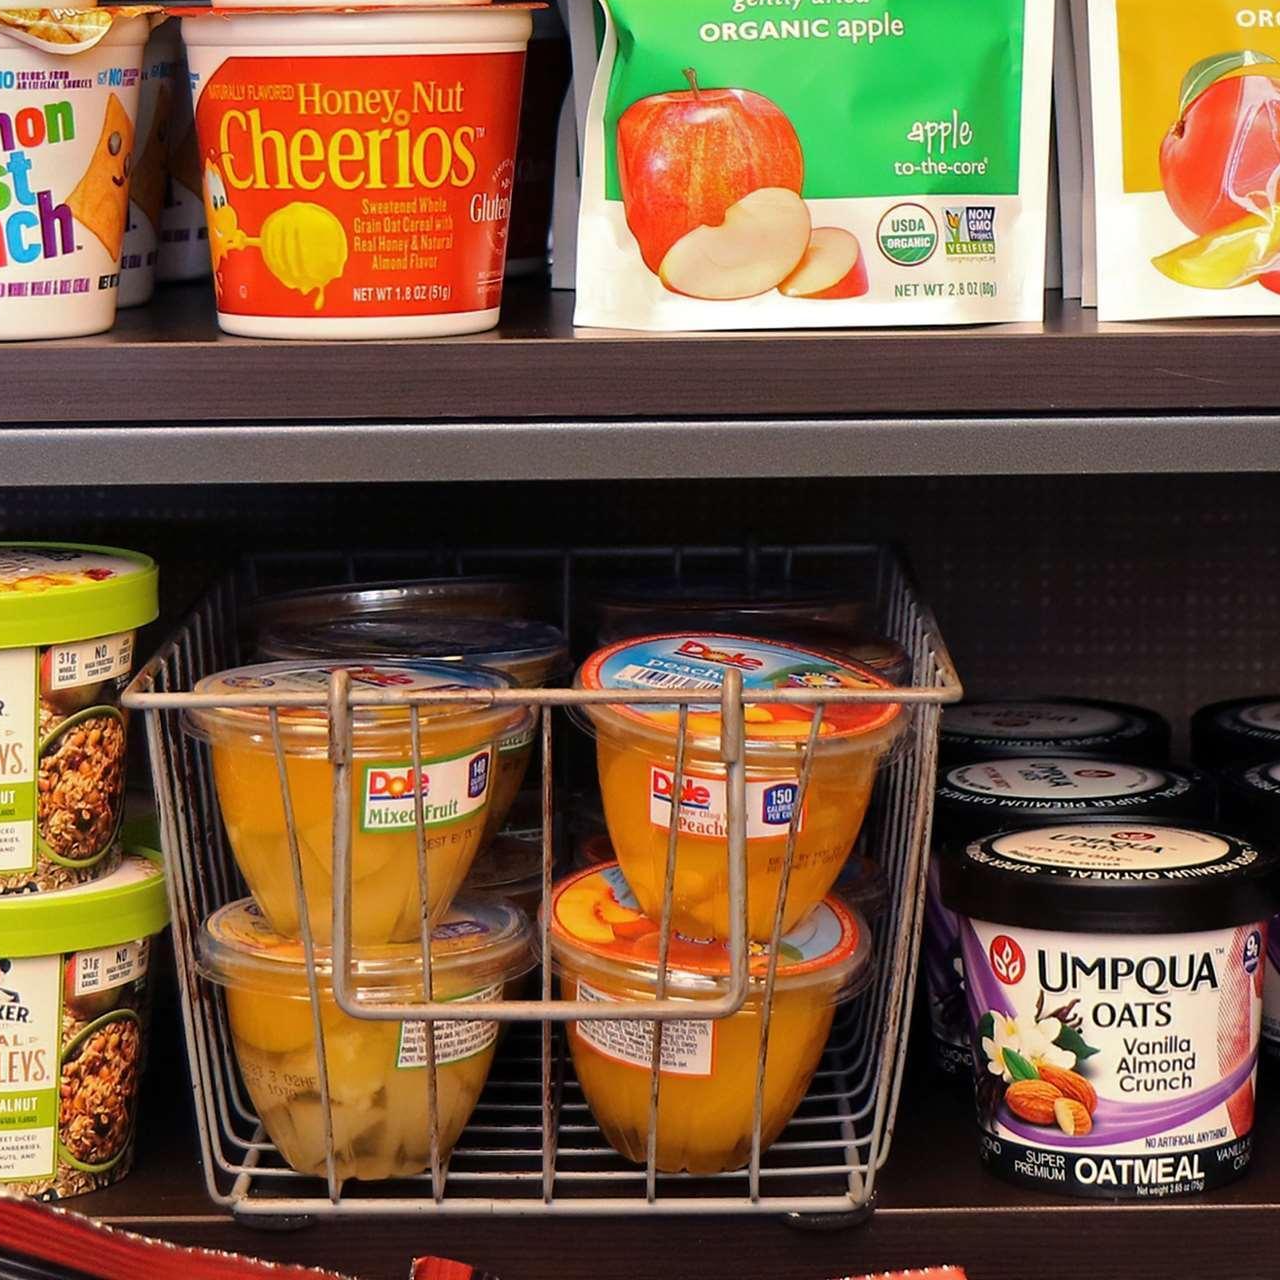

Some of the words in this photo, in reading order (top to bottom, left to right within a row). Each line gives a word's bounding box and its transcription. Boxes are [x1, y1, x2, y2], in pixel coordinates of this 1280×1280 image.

[699, 19, 829, 42] ORGANIC
[838, 13, 905, 44] apple
[298, 83, 401, 125] Honey
[412, 81, 465, 113] Nut
[907, 109, 974, 154] apple
[219, 107, 477, 190] Cheerios
[894, 159, 986, 176] to-the-core
[892, 219, 925, 234] USDA
[885, 236, 932, 249] ORGANIC
[946, 242, 995, 253] VERIFIED
[894, 283, 919, 296] NET
[923, 283, 945, 296] WT
[682, 640, 763, 667] Dole
[425, 800, 458, 820] Fruit
[1037, 950, 1218, 994] UMPQUA
[1092, 1001, 1171, 1028] OATS
[1123, 1037, 1191, 1054] Vanilla
[1116, 1054, 1195, 1074] Almond
[1119, 1075, 1192, 1092] Crunch
[1158, 1132, 1195, 1148] ARTIFICIAL
[1026, 1151, 1065, 1167] SUPER
[1074, 1154, 1204, 1184] OATMEAL
[1015, 1161, 1066, 1181] PREMIUM
